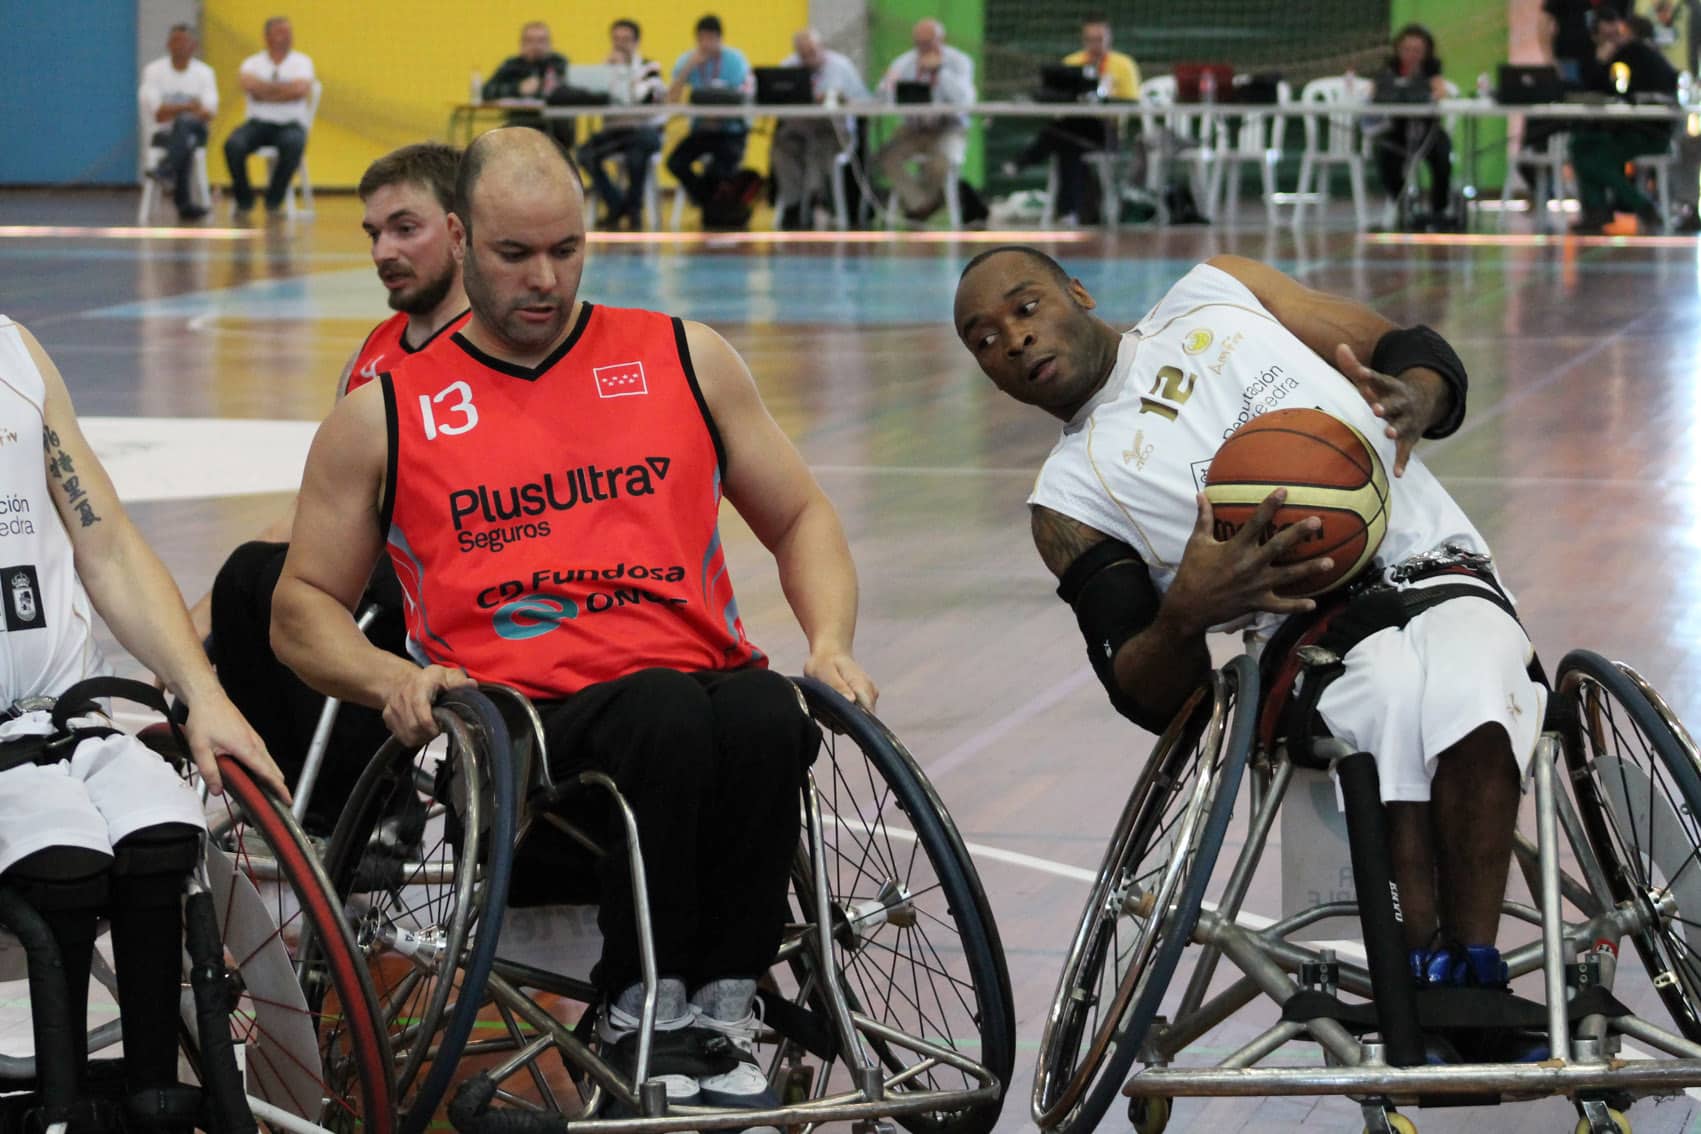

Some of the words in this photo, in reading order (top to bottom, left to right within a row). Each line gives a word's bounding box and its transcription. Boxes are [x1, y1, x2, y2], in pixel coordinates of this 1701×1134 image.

[419, 381, 479, 440] 13
[1139, 365, 1198, 422] 12
[449, 463, 655, 531] PlusUltra
[456, 521, 552, 553] Seguros
[476, 579, 525, 610] CD
[532, 563, 686, 591] Fundosa
